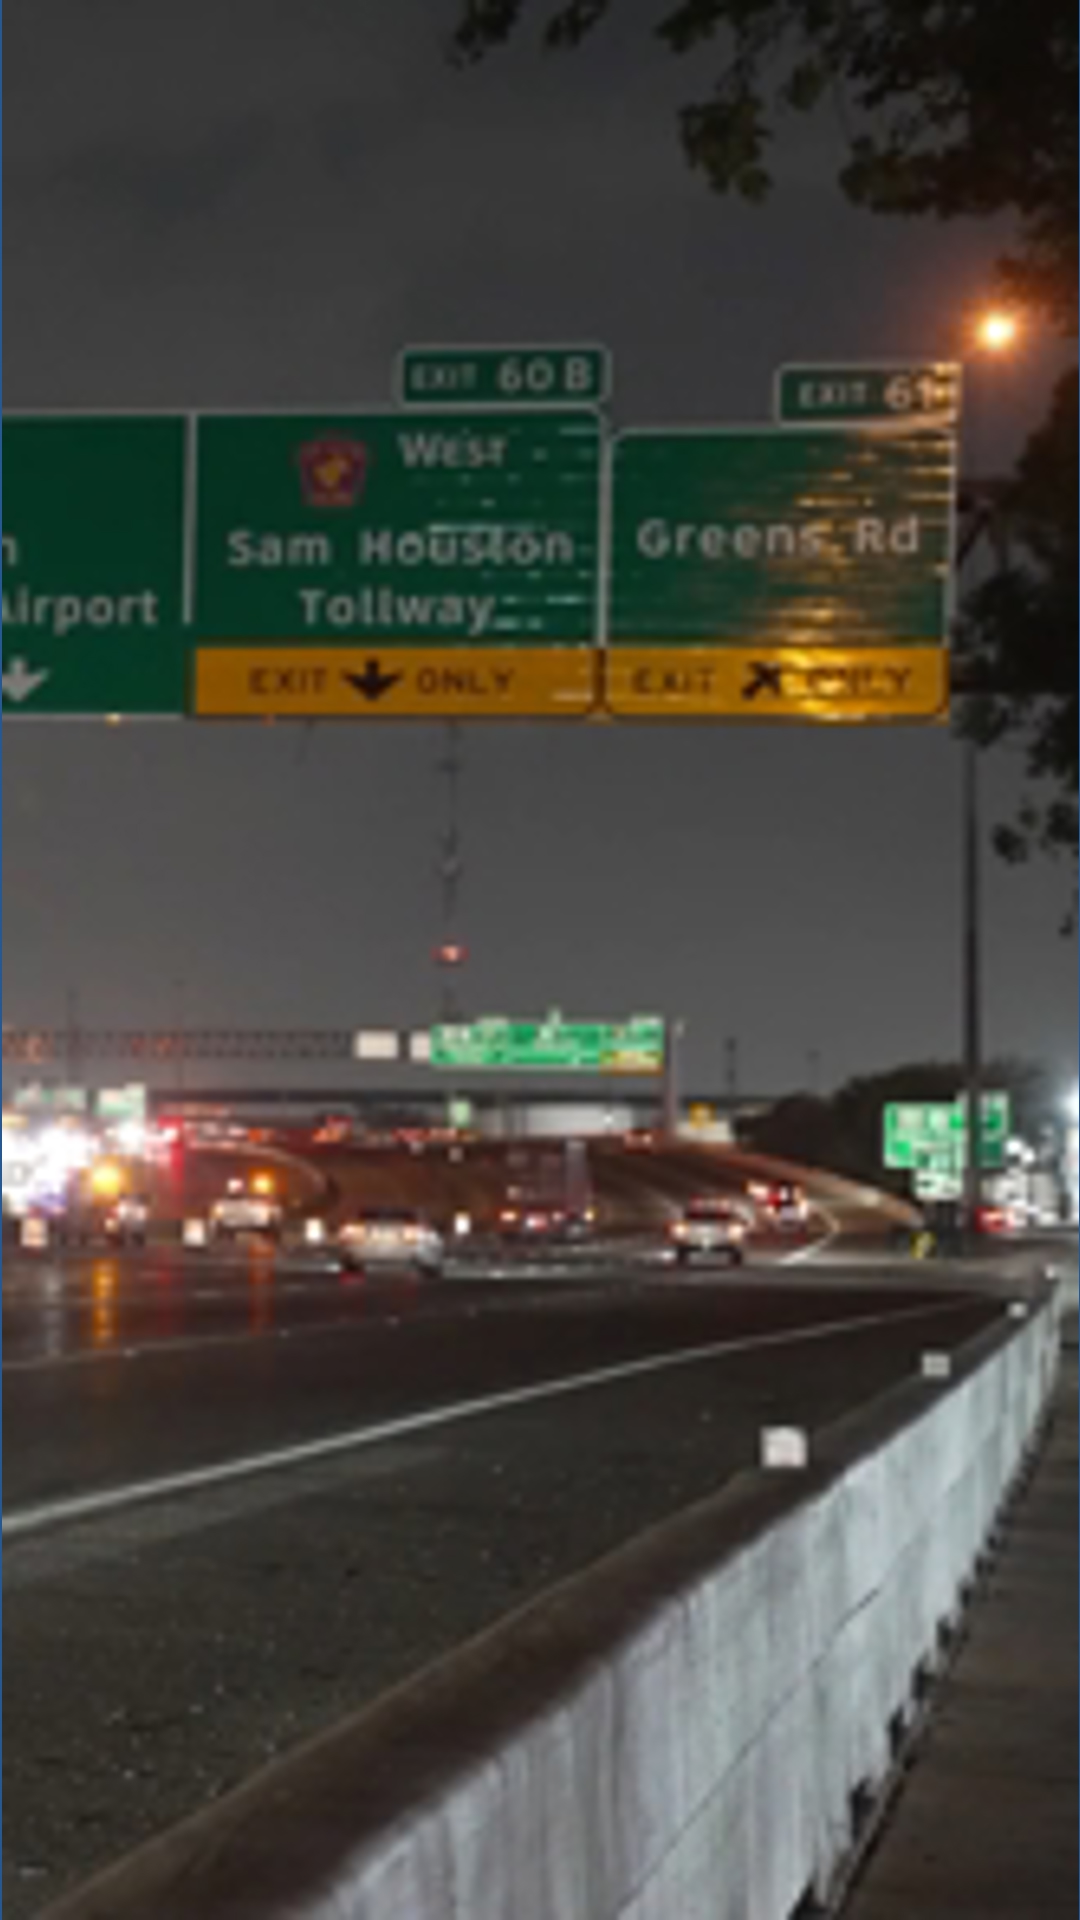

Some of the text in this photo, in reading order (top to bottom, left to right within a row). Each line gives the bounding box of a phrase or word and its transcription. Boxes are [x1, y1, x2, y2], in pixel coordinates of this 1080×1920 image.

[410, 356, 594, 394] EXIT 60 B
[798, 381, 868, 410] EXIT
[227, 526, 574, 567] Sam Houston
[636, 515, 920, 558] Greens Rd
[299, 587, 496, 636] Tollway
[248, 665, 515, 695] EXIT ONLY
[631, 666, 717, 695] EXIT
